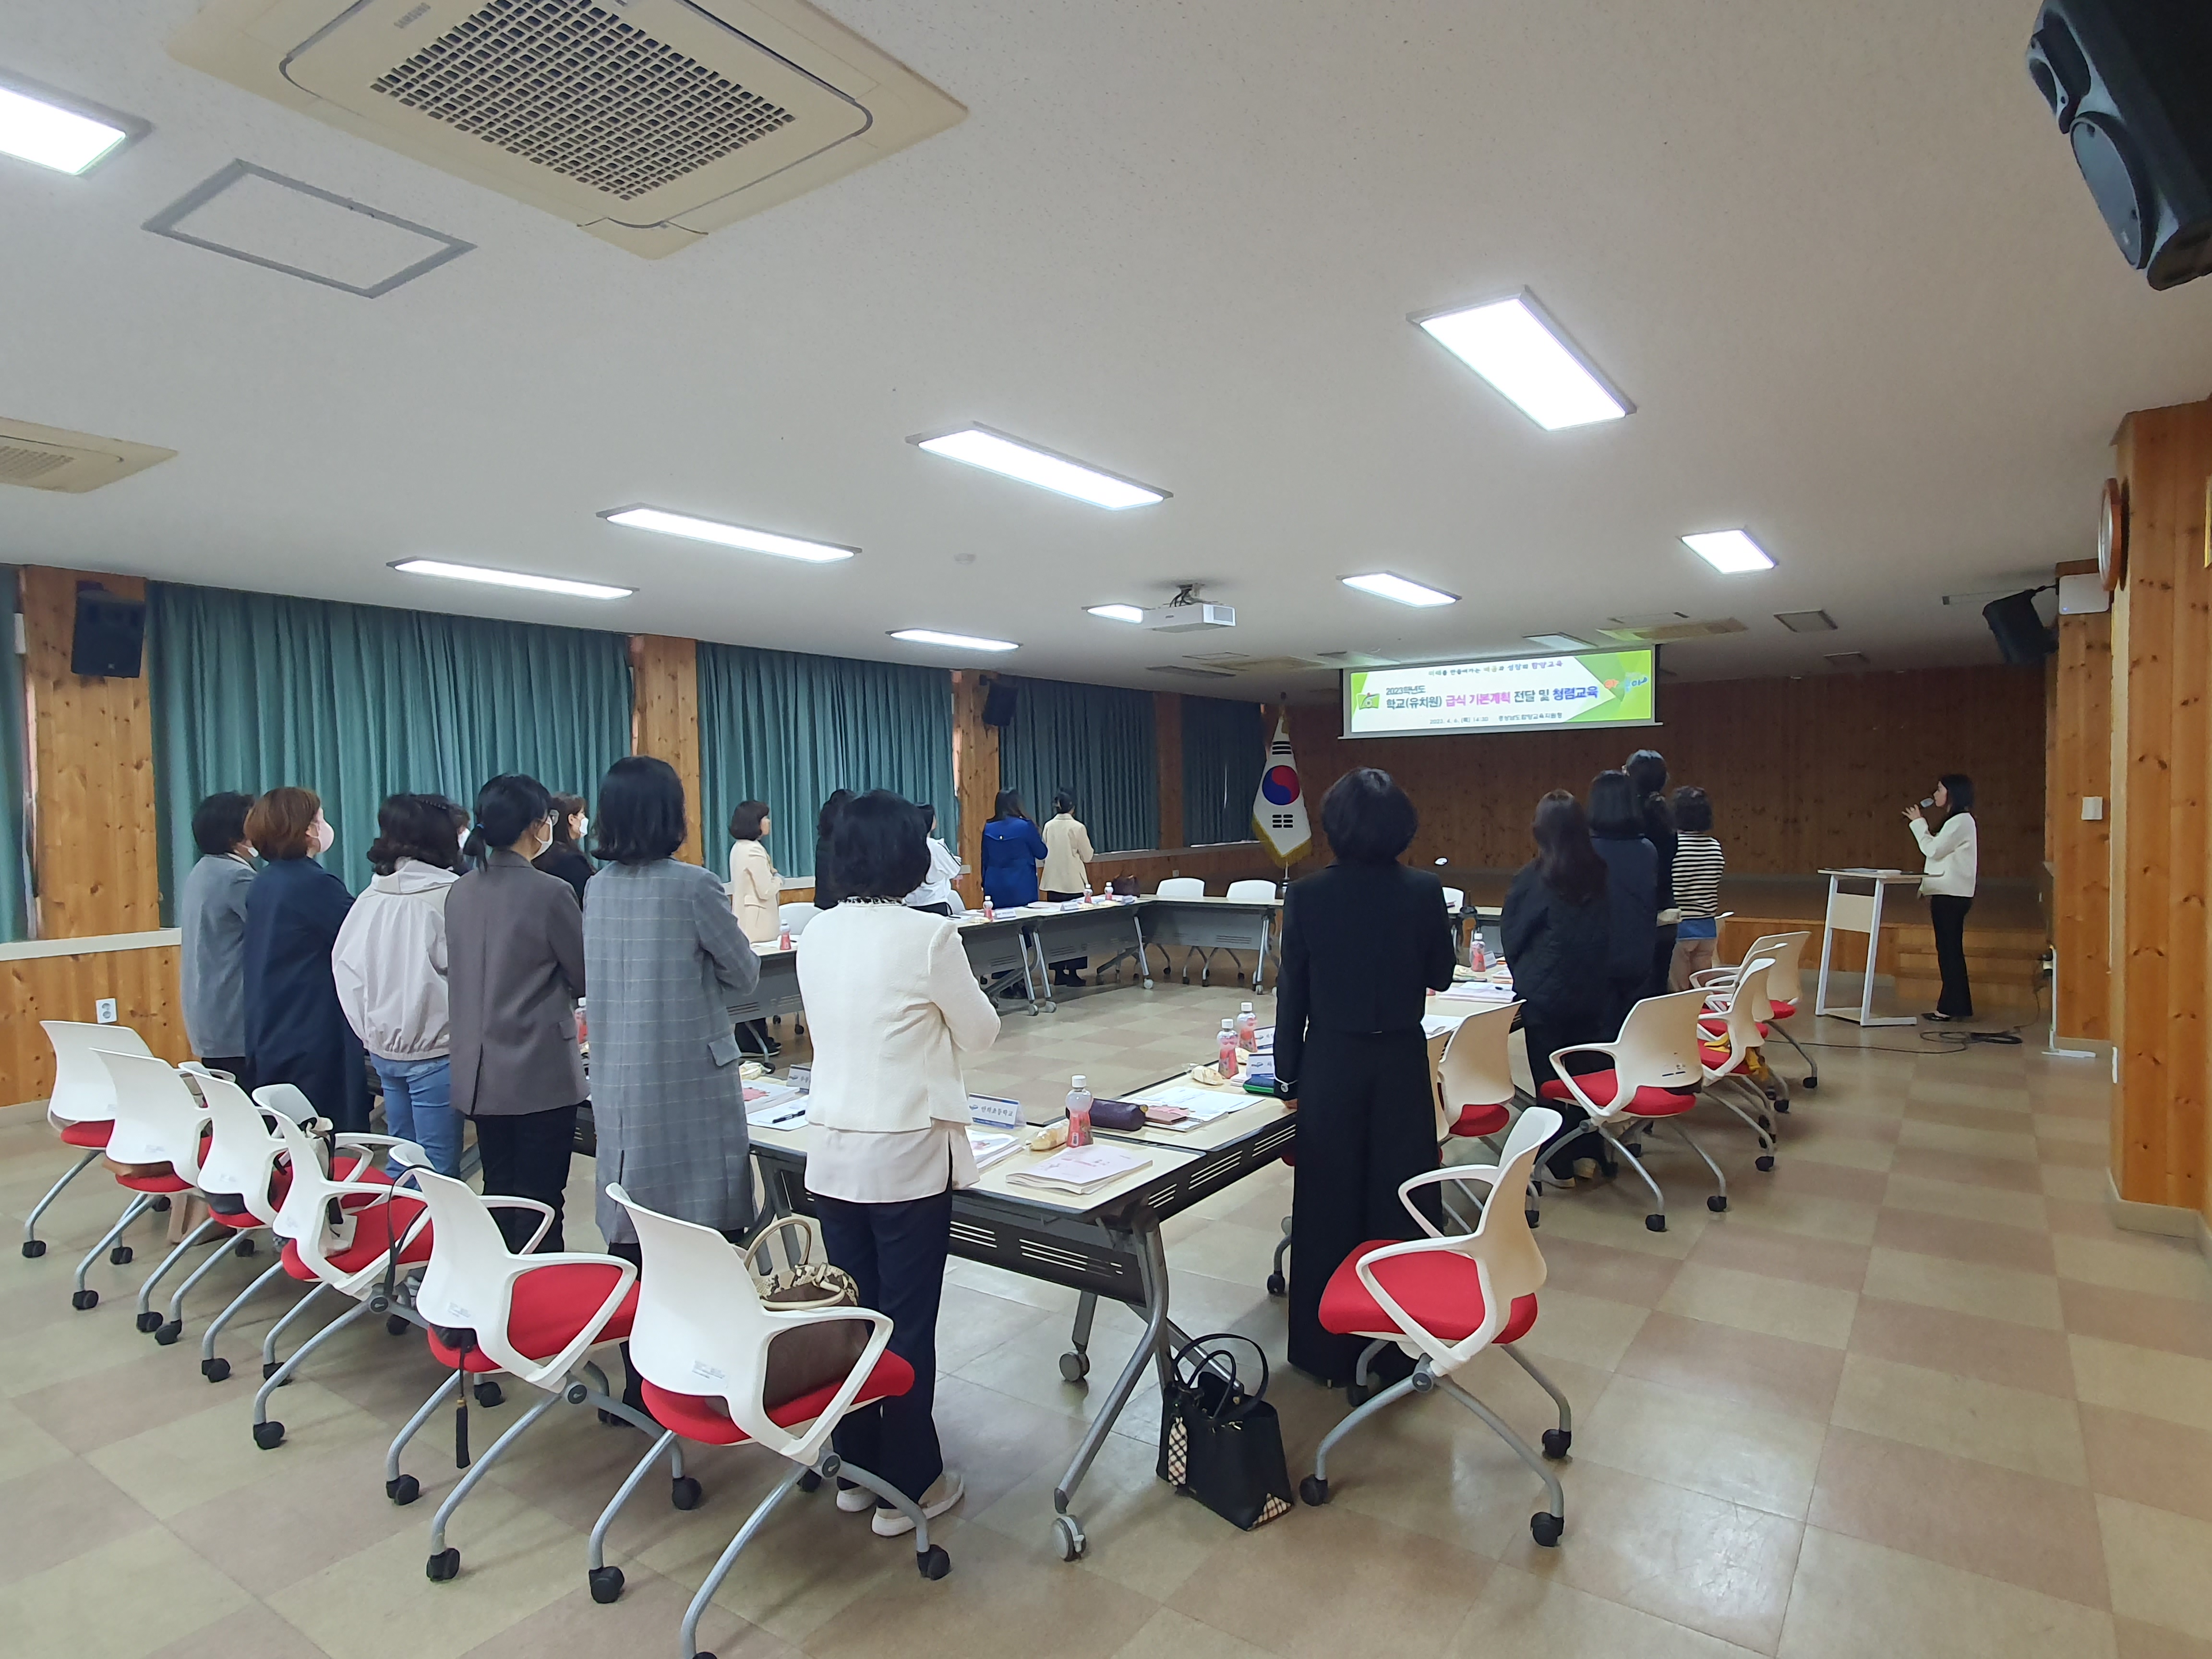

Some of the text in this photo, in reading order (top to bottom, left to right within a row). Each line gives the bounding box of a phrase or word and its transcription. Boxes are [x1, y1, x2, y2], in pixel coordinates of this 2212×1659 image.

[1386, 685, 1426, 695] 2023학년도
[1386, 686, 1598, 710] 학교(유치원) 급식 기본계획 전달 및 청렴교육
